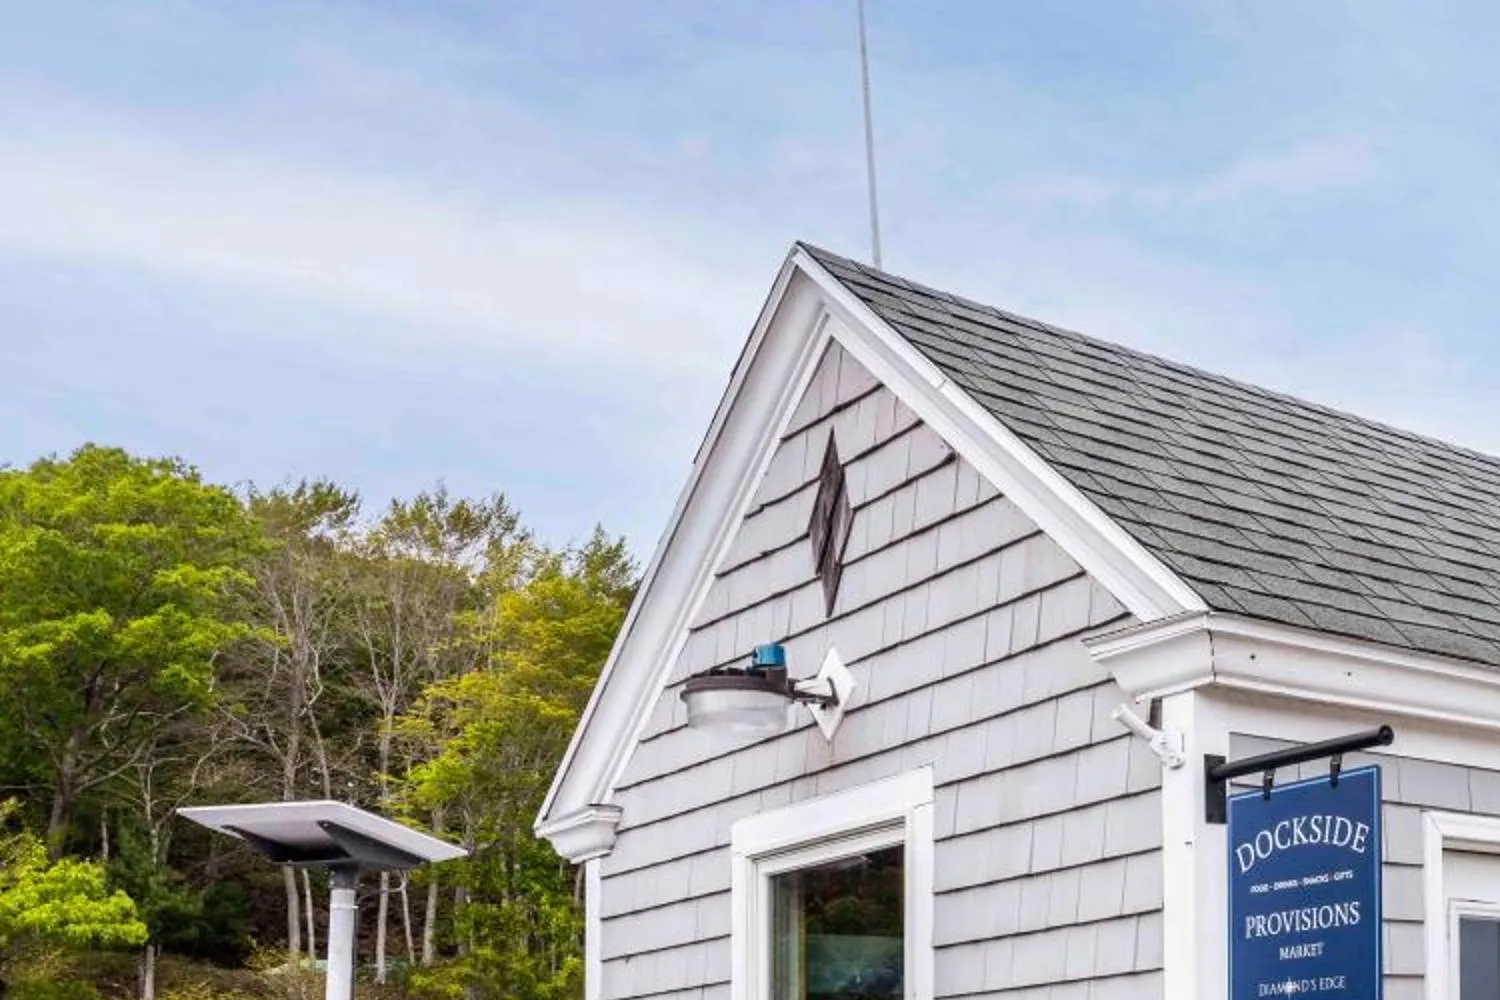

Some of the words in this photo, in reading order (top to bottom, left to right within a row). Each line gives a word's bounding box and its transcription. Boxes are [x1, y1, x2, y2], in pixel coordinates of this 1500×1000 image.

[1235, 815, 1369, 872] DOCKSIDE
[1245, 901, 1361, 938] PROVISIONS
[1279, 942, 1325, 960] MARKET
[1319, 975, 1345, 991] EDGE
